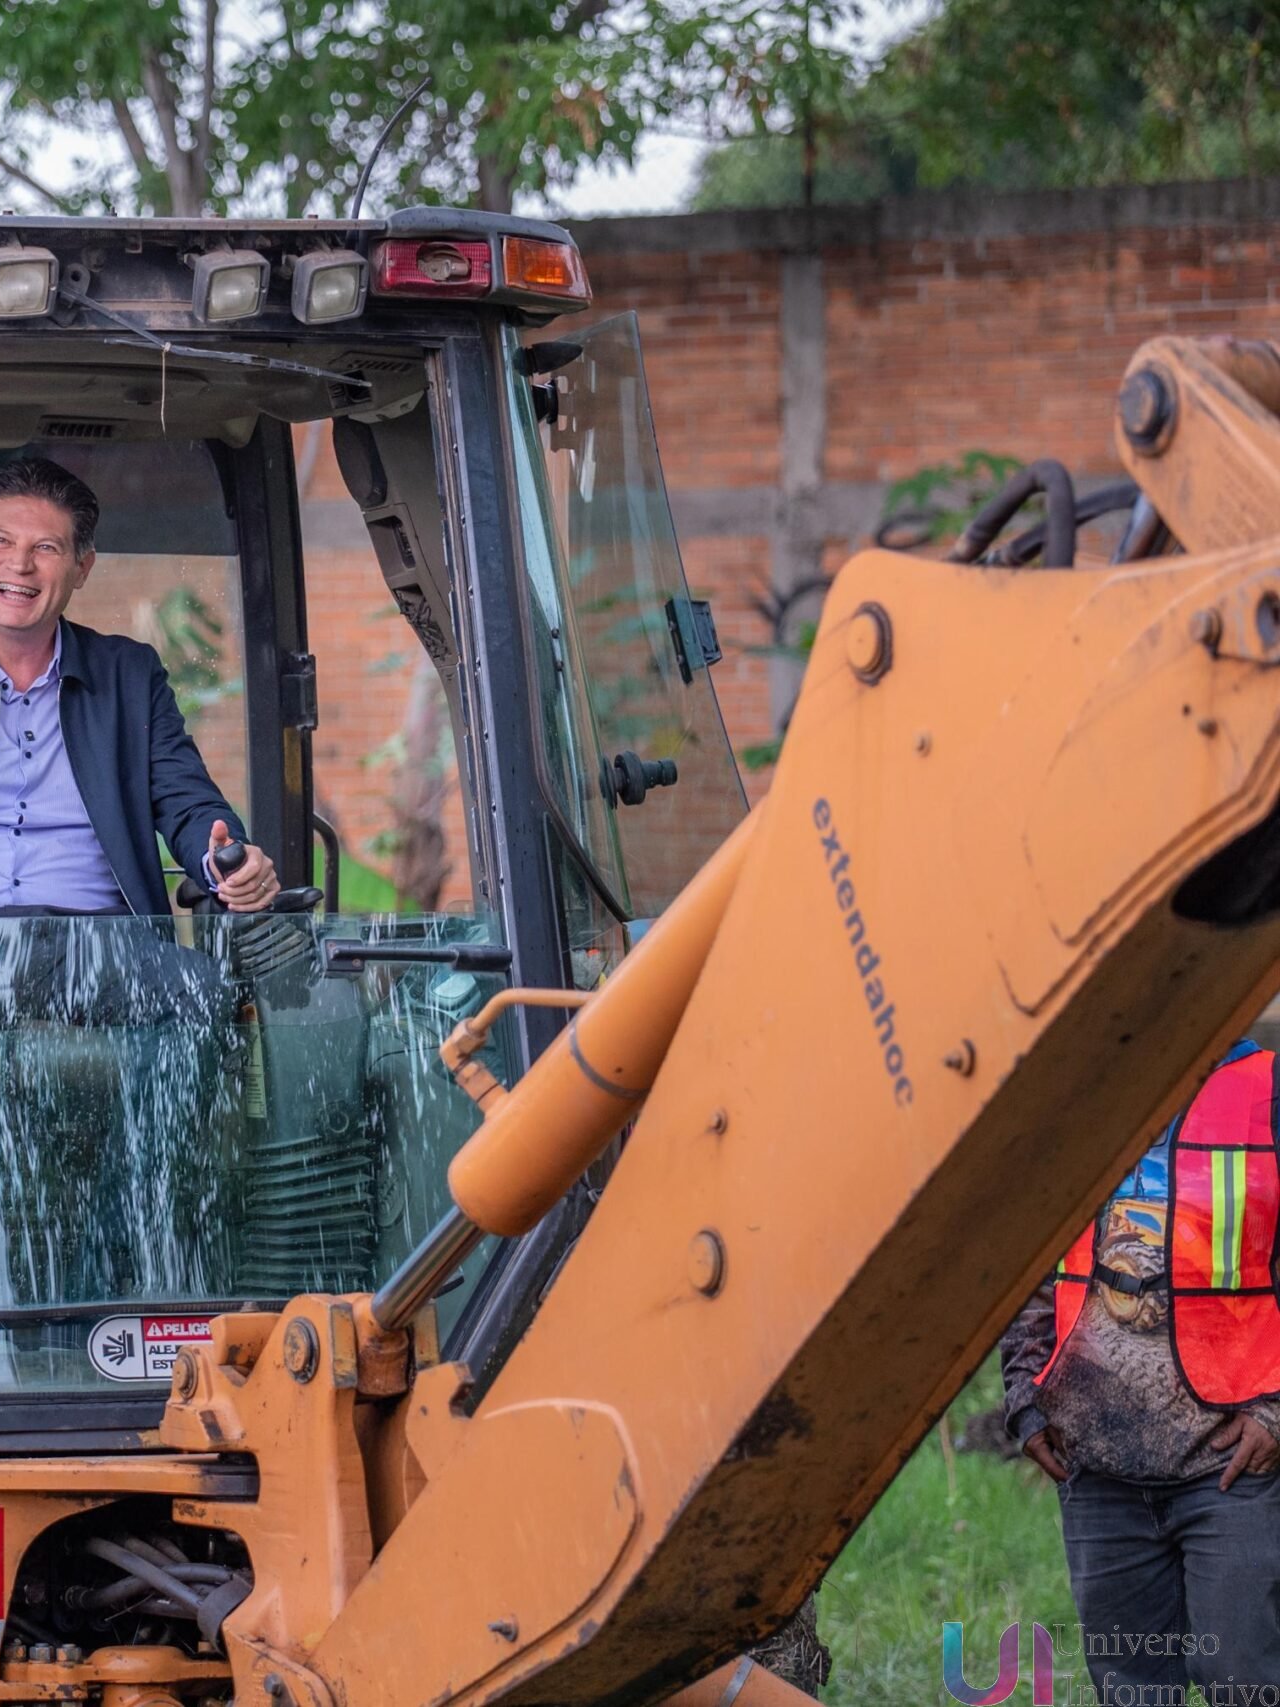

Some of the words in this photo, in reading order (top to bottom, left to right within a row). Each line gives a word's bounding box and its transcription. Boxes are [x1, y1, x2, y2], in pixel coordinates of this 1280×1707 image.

[162, 1323, 210, 1336] PELIGR
[149, 1344, 180, 1354] ALEJ
[153, 1359, 175, 1369] EST
